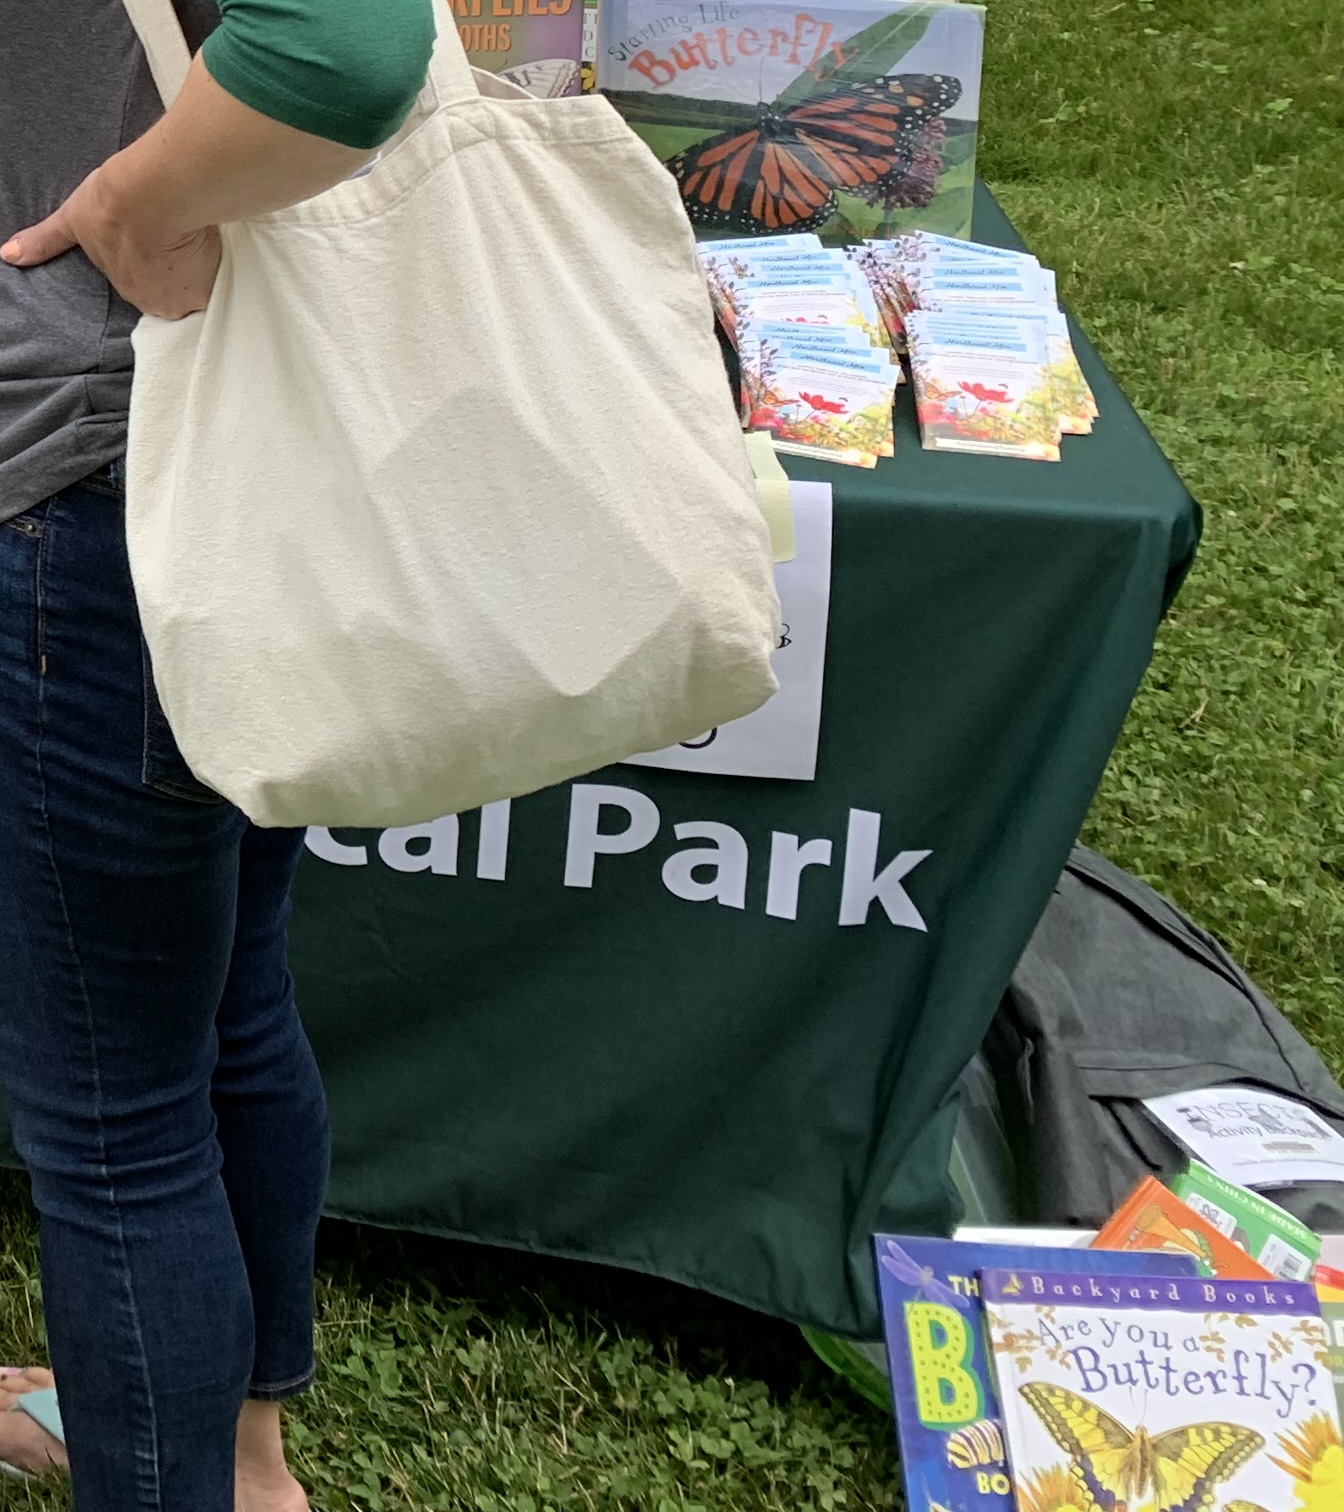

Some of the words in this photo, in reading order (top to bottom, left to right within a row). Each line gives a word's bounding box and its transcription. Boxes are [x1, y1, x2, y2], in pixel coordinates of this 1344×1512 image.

[608, 14, 693, 61] Starting
[698, 0, 741, 25] Life
[629, 12, 861, 89] Butterfly
[563, 783, 933, 934] Park
[1209, 1123, 1263, 1138] Activity
[1206, 1175, 1249, 1204] CHINA
[1251, 1201, 1265, 1215] IN
[1268, 1212, 1308, 1239] MADE
[1032, 1277, 1182, 1303] Backyard
[1203, 1284, 1296, 1306] Books
[1037, 1317, 1092, 1346] Are
[1100, 1316, 1174, 1351] you
[1183, 1335, 1200, 1352] a
[1068, 1345, 1317, 1419] Butterfly?
